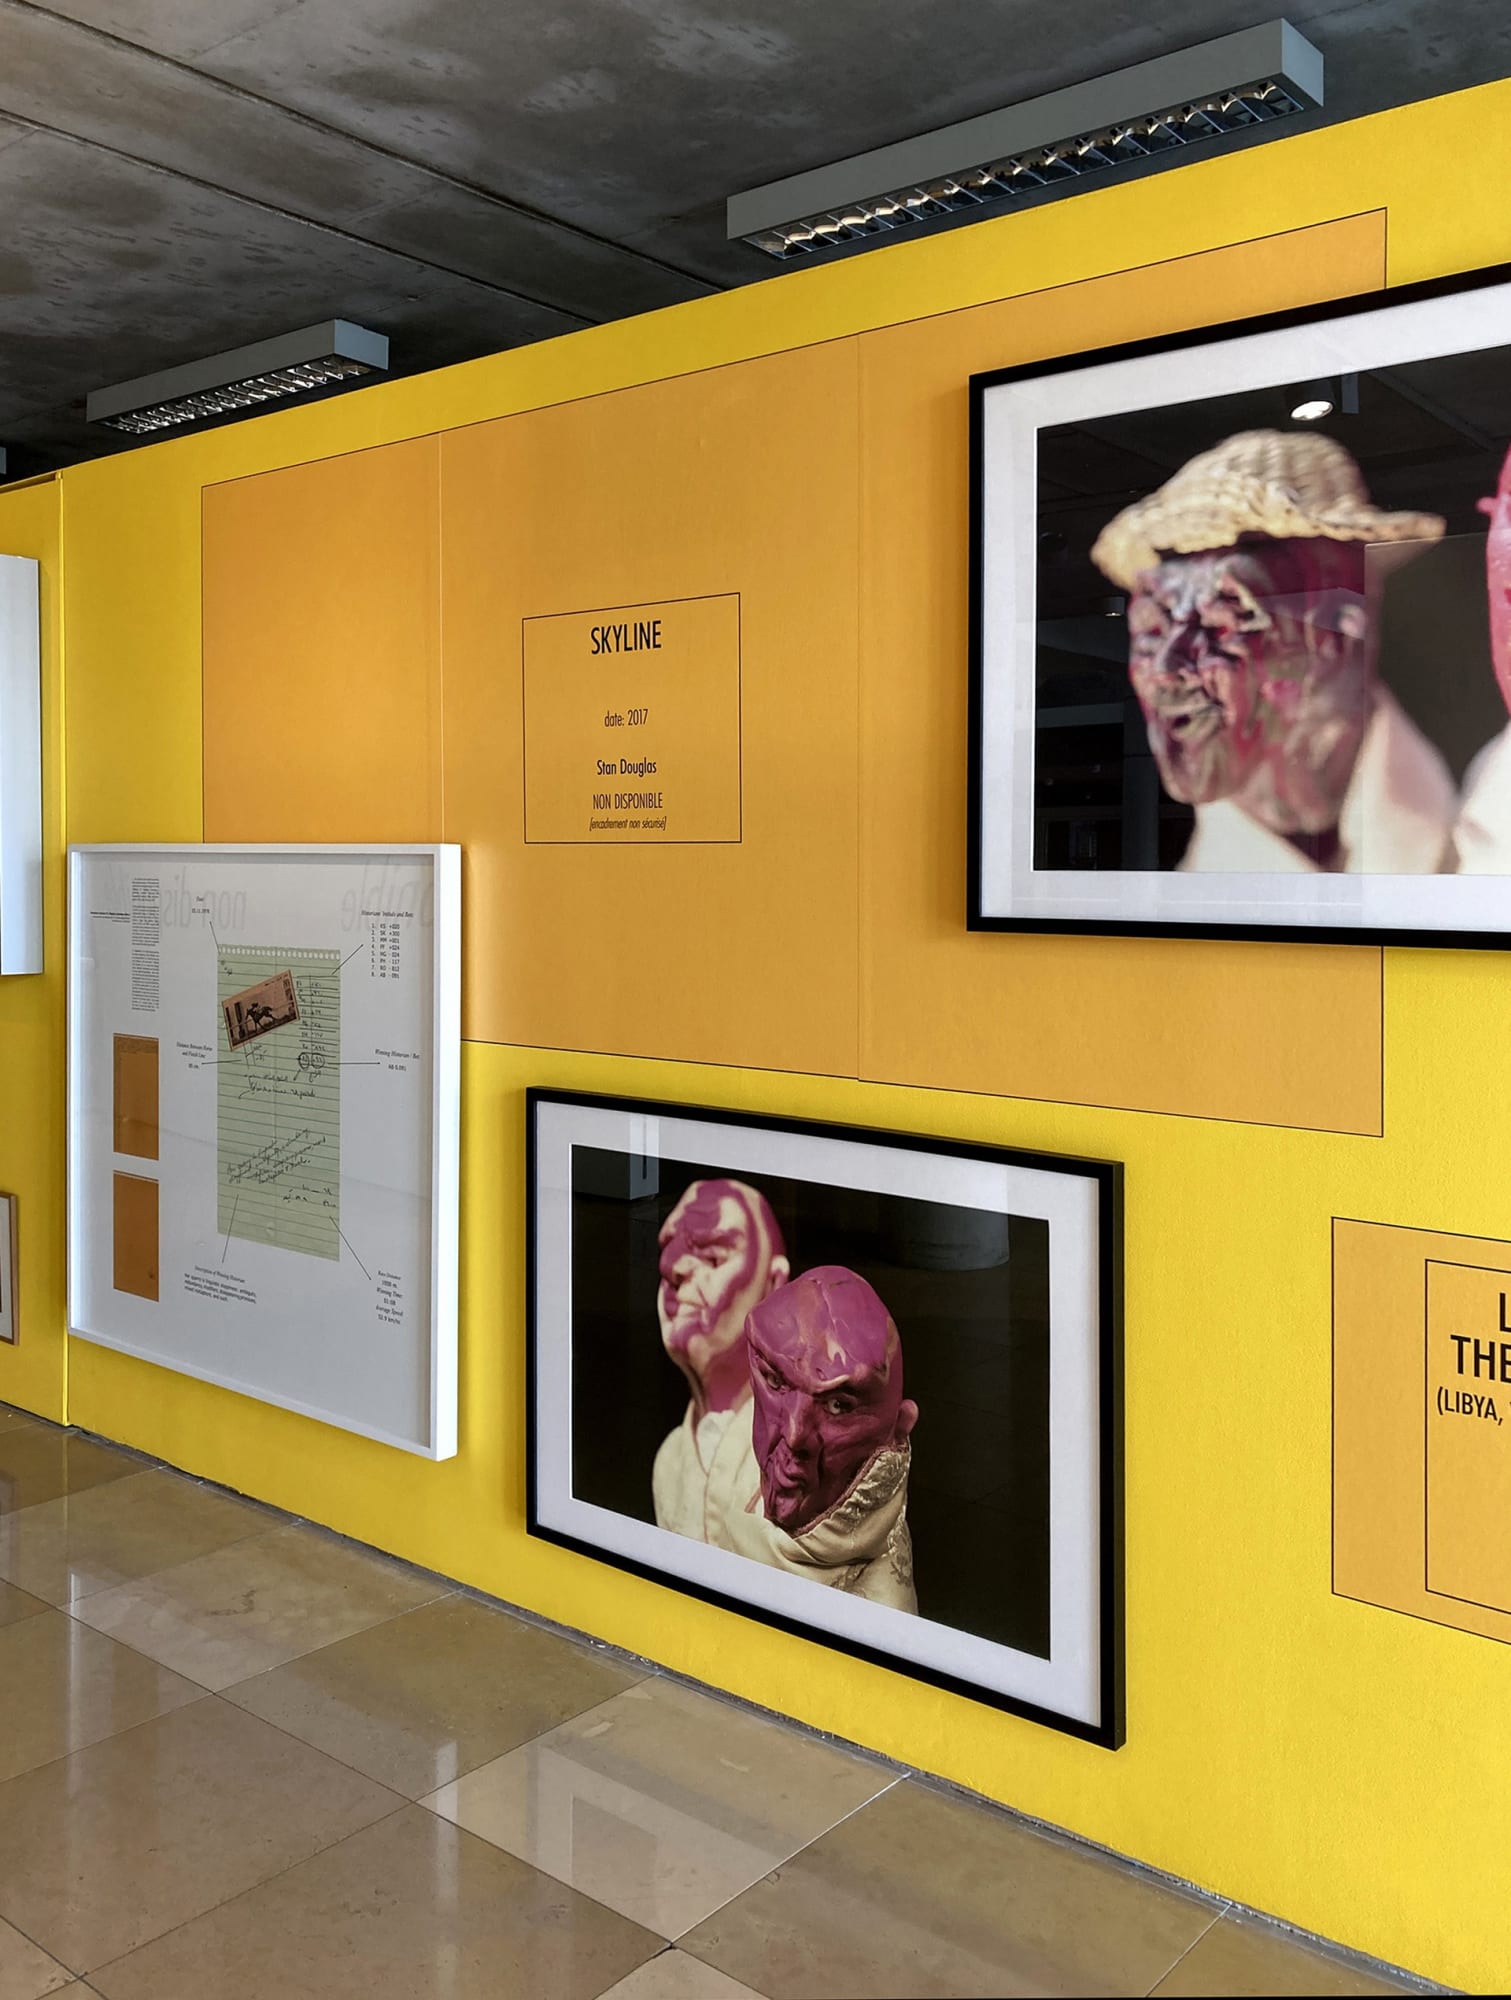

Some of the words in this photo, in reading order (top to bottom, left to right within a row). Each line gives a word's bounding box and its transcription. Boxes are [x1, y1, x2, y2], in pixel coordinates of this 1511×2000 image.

[590, 619, 662, 656] SKYLINE
[604, 710, 625, 727] date:
[628, 708, 649, 727] 2017
[596, 758, 617, 776] Stan
[620, 755, 658, 778] Douglas
[592, 792, 612, 810] NON
[615, 792, 664, 810] DISPONIBLE
[629, 820, 641, 830] non
[1449, 1333, 1511, 1385] THE
[1436, 1386, 1504, 1427] (LIBYA,
